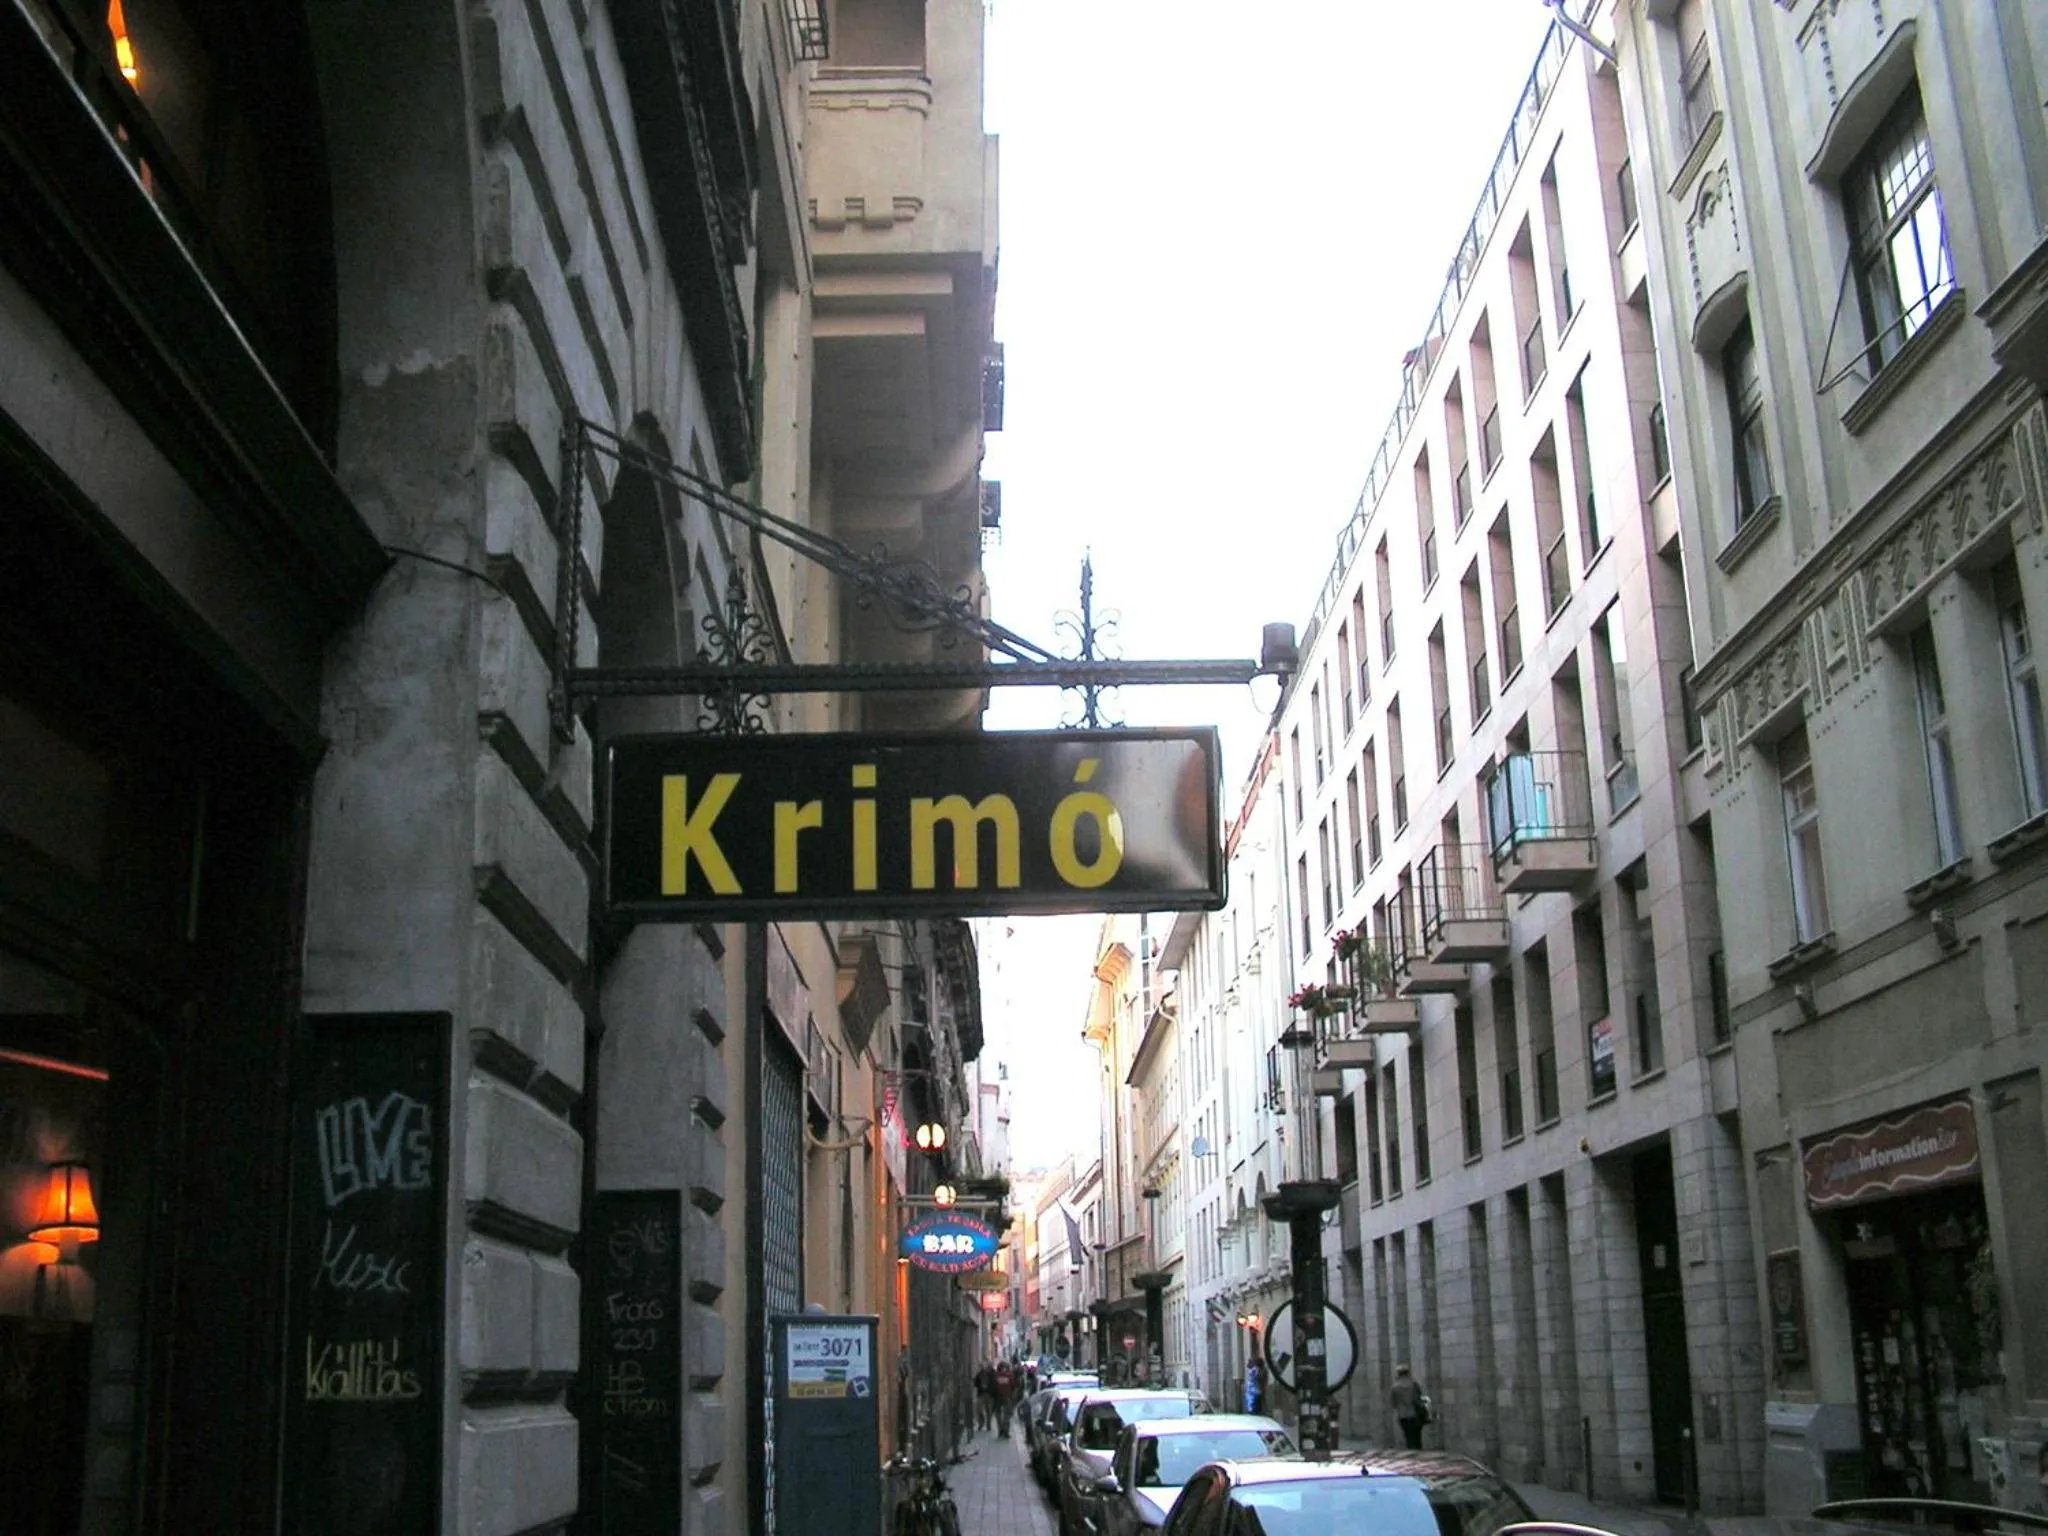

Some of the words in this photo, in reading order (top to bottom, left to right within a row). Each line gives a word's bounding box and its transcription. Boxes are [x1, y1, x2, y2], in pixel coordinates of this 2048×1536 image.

[661, 757, 1124, 895] Krimó
[923, 1233, 974, 1254] BAR
[820, 1337, 861, 1357] 3071
